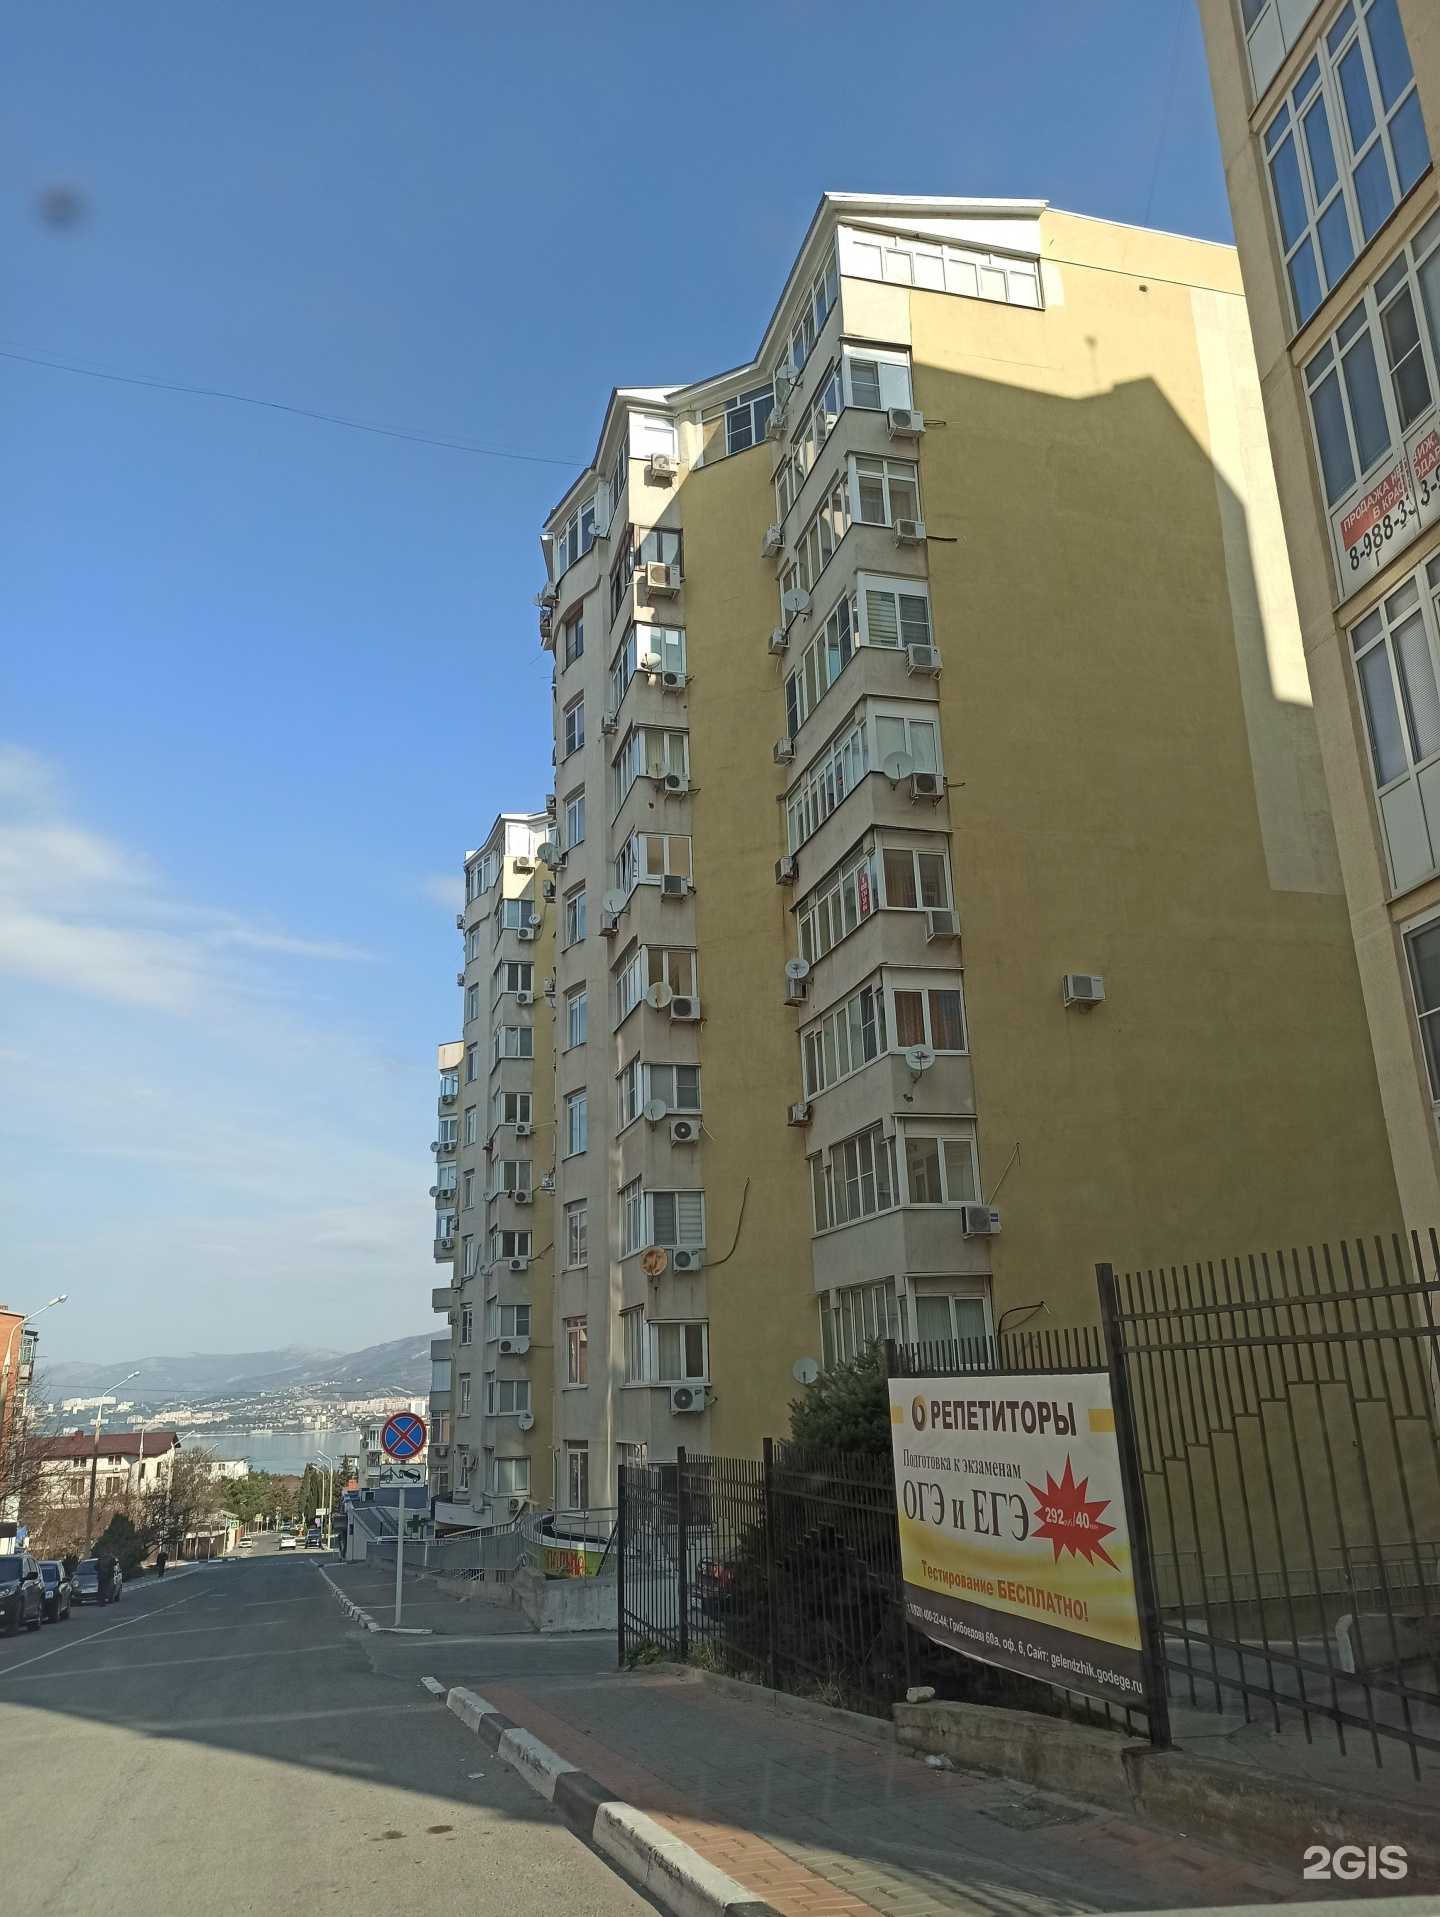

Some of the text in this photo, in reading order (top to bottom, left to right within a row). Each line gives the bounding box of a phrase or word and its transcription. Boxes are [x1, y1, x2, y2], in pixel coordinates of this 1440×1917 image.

[1343, 480, 1391, 532] ПРОДАЖА
[1373, 504, 1380, 519] В
[930, 1399, 1077, 1436] РЕПЕТИТОРЫ
[903, 1448, 1022, 1480] Подготовка к экзаменам
[903, 1479, 1030, 1542] ОГЭ и ЕГЭ
[921, 1559, 1089, 1622] Тестирование БЕСПЛАТНО!
[1002, 1638, 1017, 1654] оф.
[1018, 1640, 1026, 1656] 6,
[1026, 1643, 1049, 1662] Сайт:
[1050, 1653, 1143, 1695] gelendzhik.godege.ru
